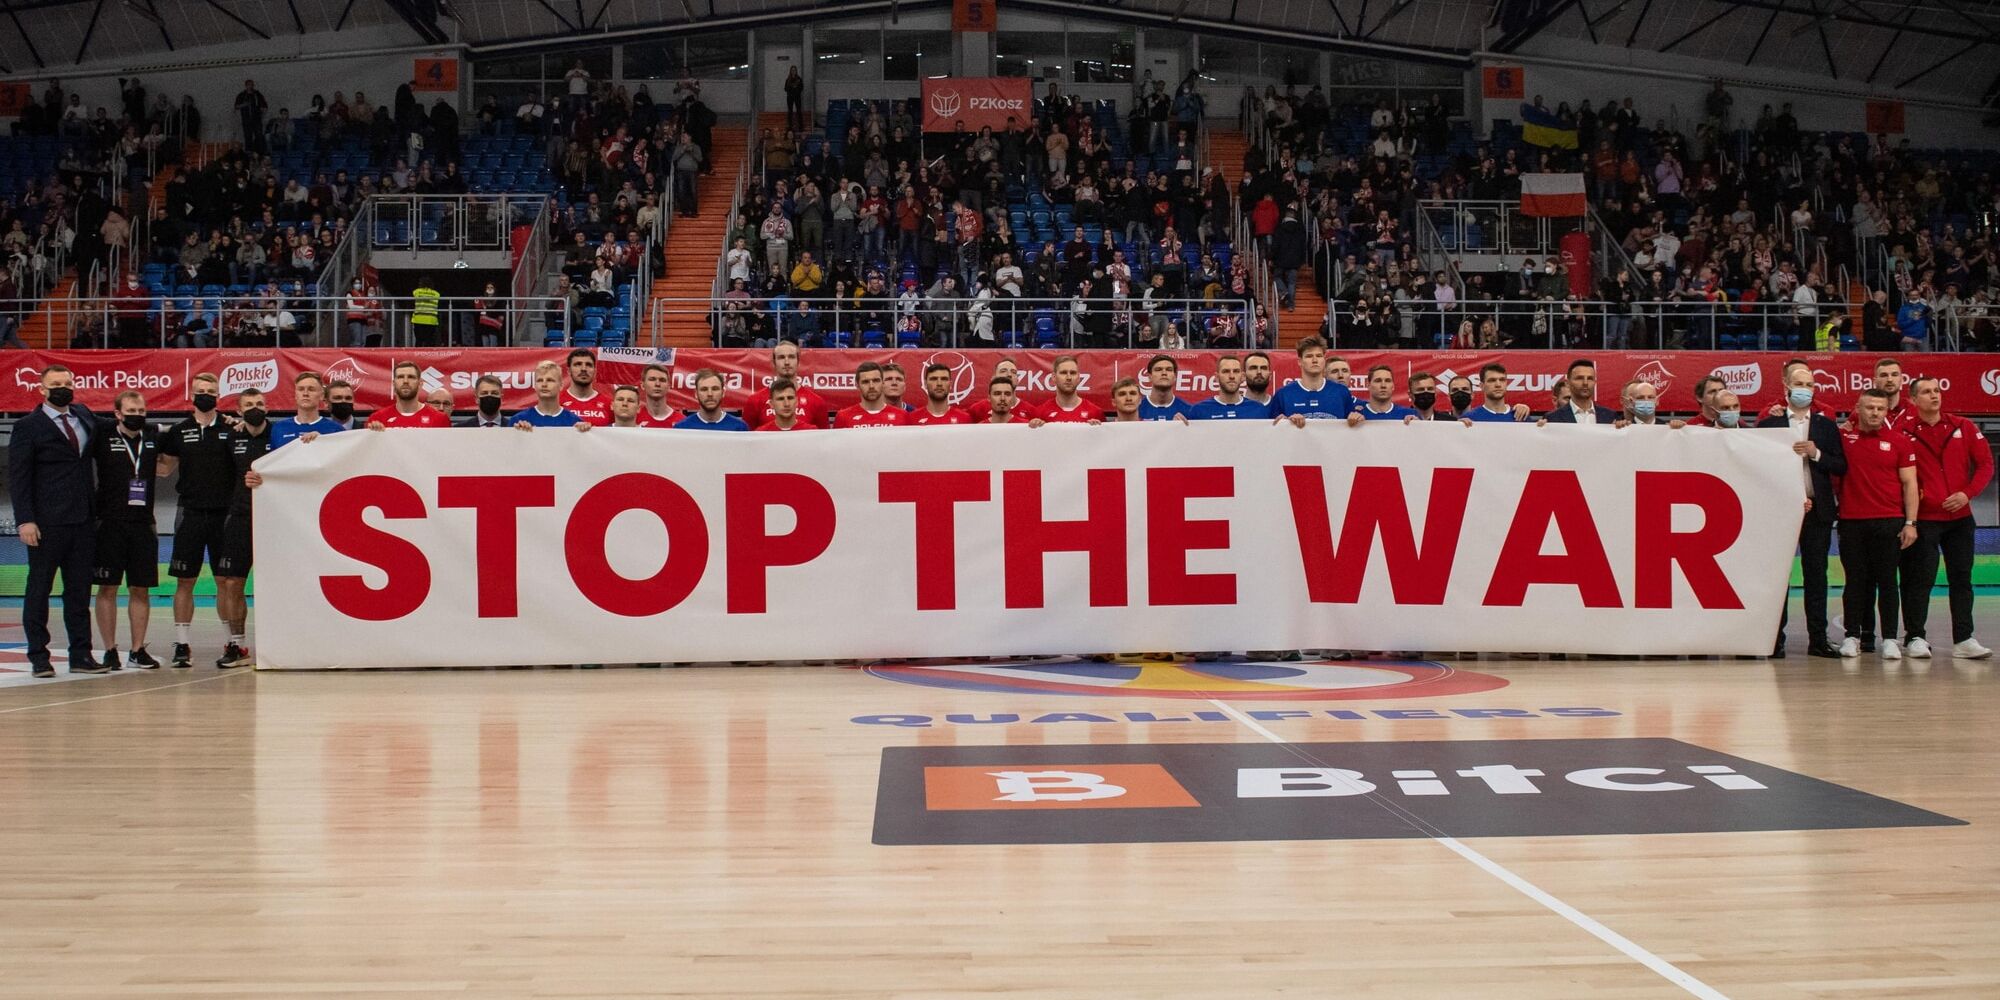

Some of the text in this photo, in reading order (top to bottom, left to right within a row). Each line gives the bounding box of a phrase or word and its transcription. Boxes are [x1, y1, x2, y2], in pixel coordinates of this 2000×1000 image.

[968, 2, 982, 22] 5
[427, 61, 443, 81] 4
[1496, 67, 1511, 89] 6
[602, 347, 653, 357] KROTOSZYN
[71, 370, 172, 389] ank Pekao
[226, 364, 273, 384] Polskie
[327, 367, 354, 384] Polski
[816, 375, 859, 388] ORLE
[229, 380, 269, 391] przetwory
[319, 466, 1744, 620] STOP THE WAR
[850, 706, 1623, 727] QUALIFIERS
